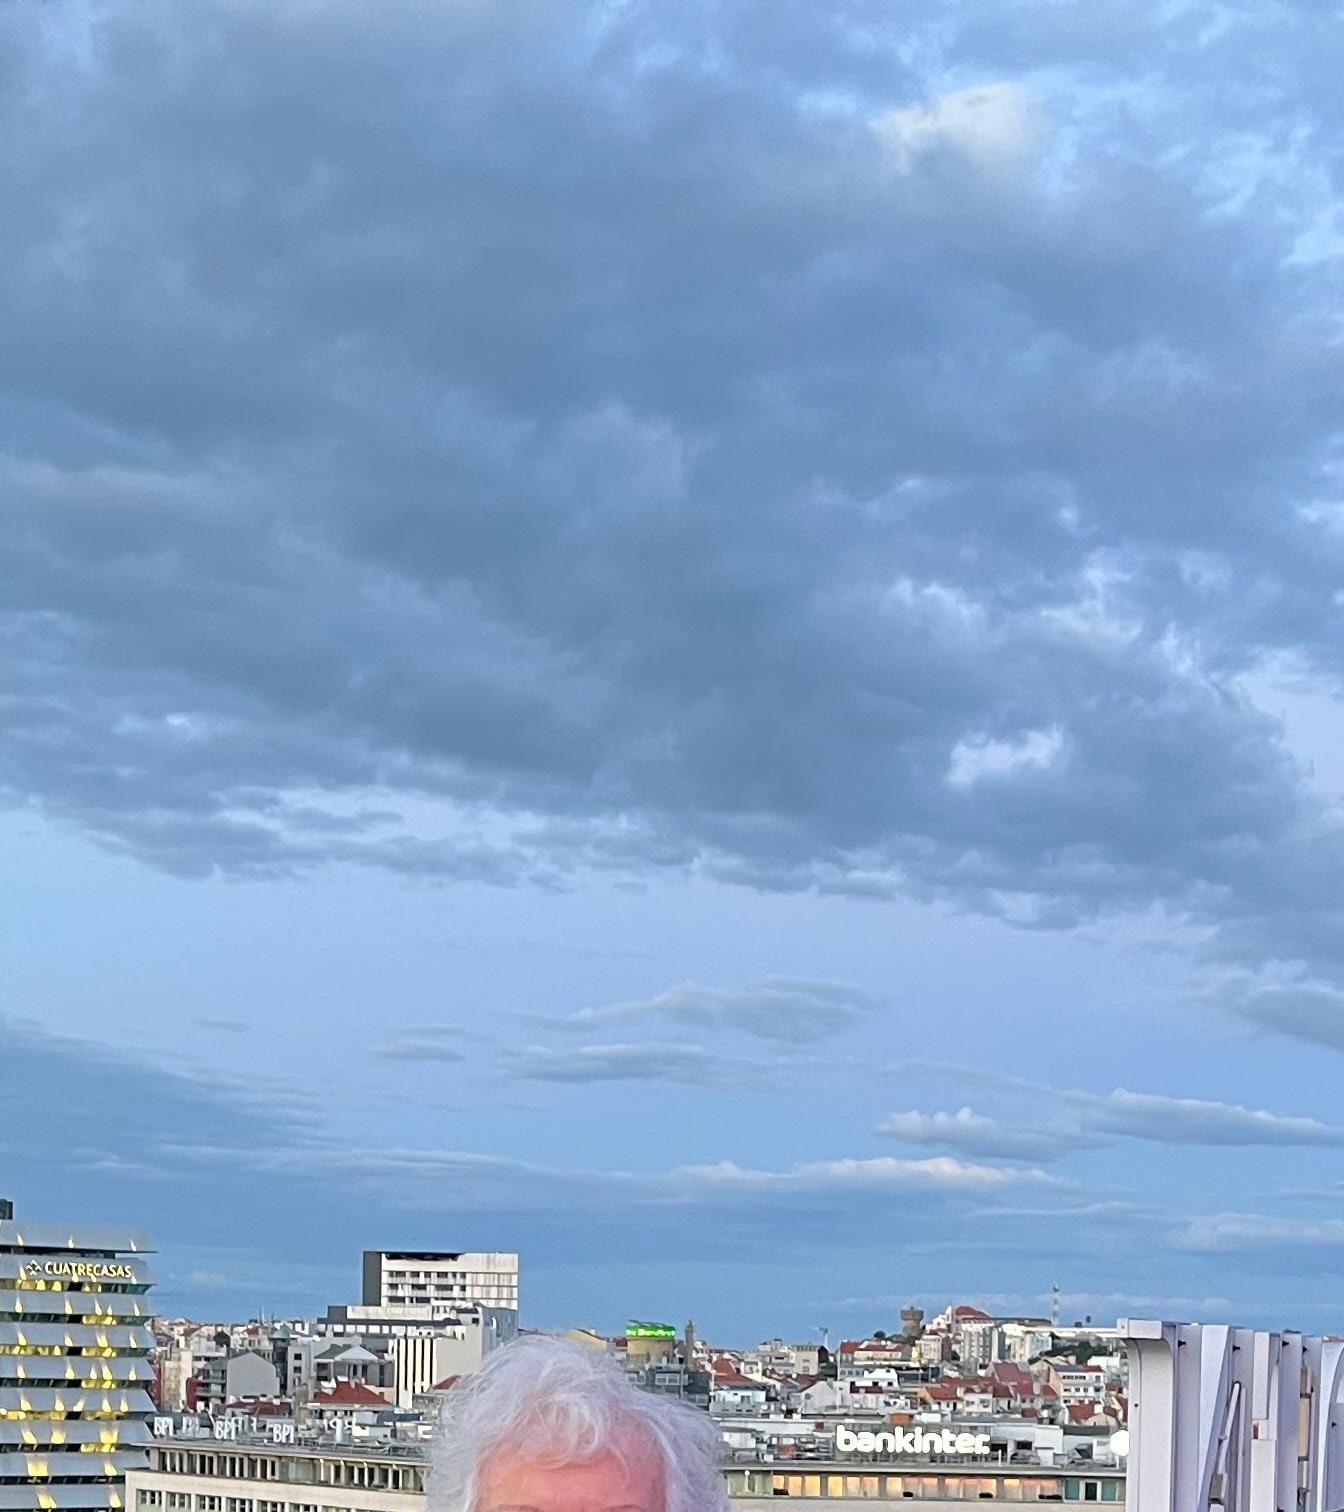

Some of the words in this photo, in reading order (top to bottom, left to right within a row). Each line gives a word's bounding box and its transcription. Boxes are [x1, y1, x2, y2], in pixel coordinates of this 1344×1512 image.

[44, 1261, 132, 1278] CUATRECASAS
[154, 1416, 174, 1437] BPI
[216, 1420, 236, 1440] BPI
[273, 1423, 295, 1443] BPI
